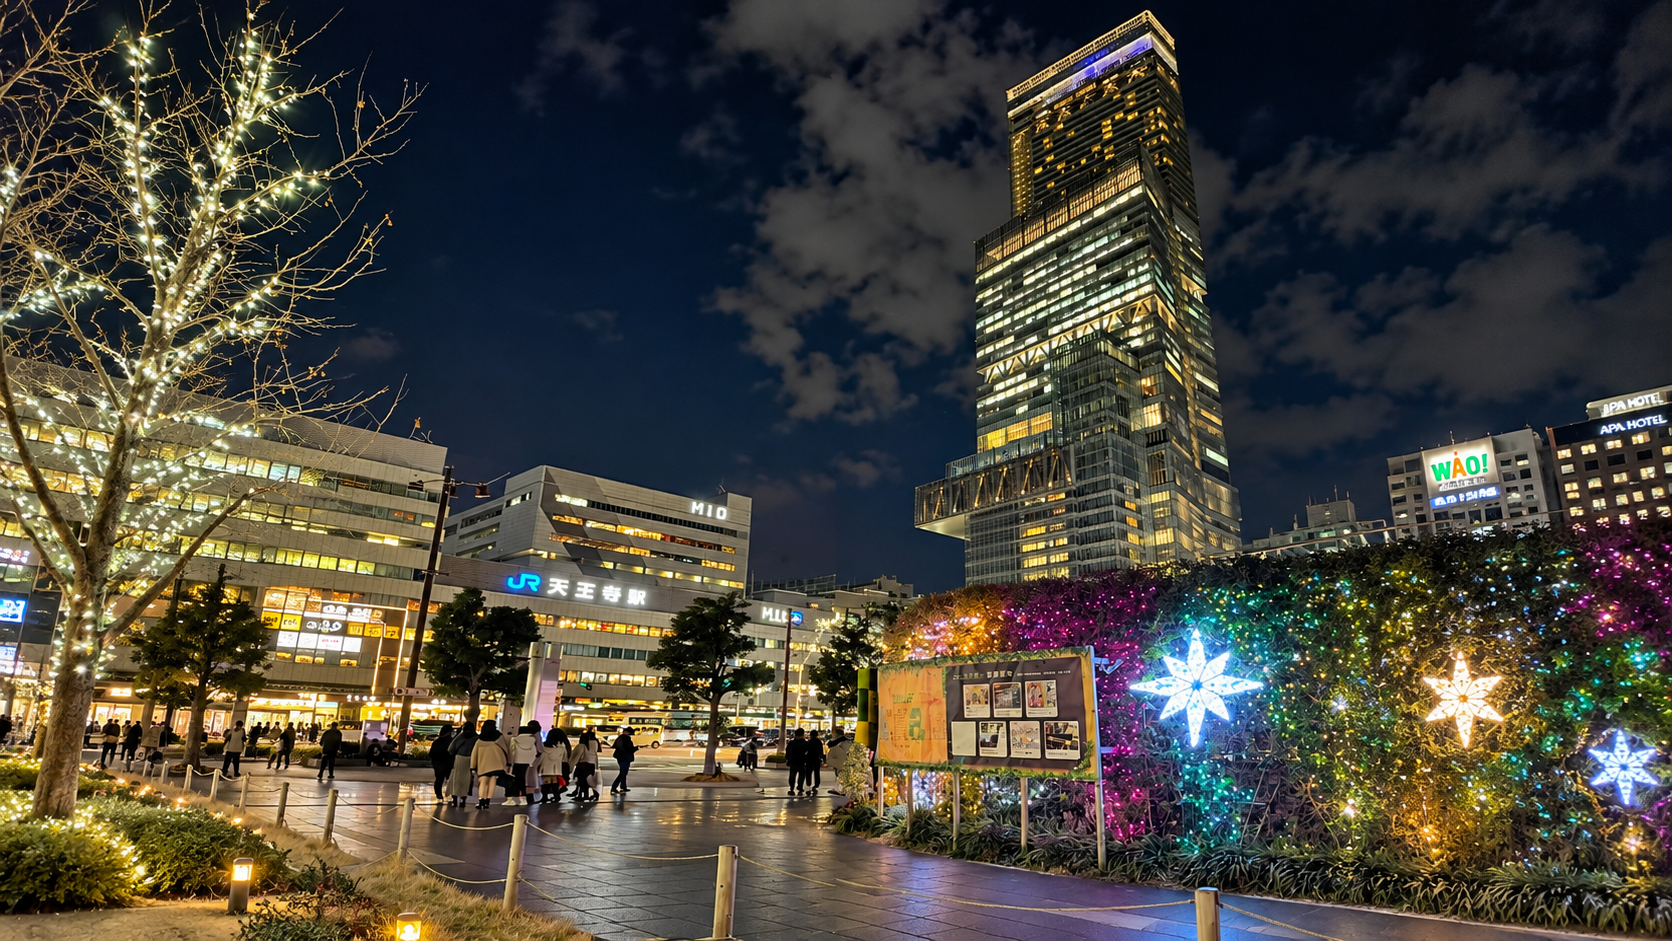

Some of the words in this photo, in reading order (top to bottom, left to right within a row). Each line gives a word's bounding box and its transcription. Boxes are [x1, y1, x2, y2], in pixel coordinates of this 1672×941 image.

[1600, 422, 1626, 435] APA
[1626, 414, 1668, 430] HOTEL
[691, 501, 728, 520] MIO
[507, 573, 541, 592] JR
[547, 577, 646, 605] 天王寺駅
